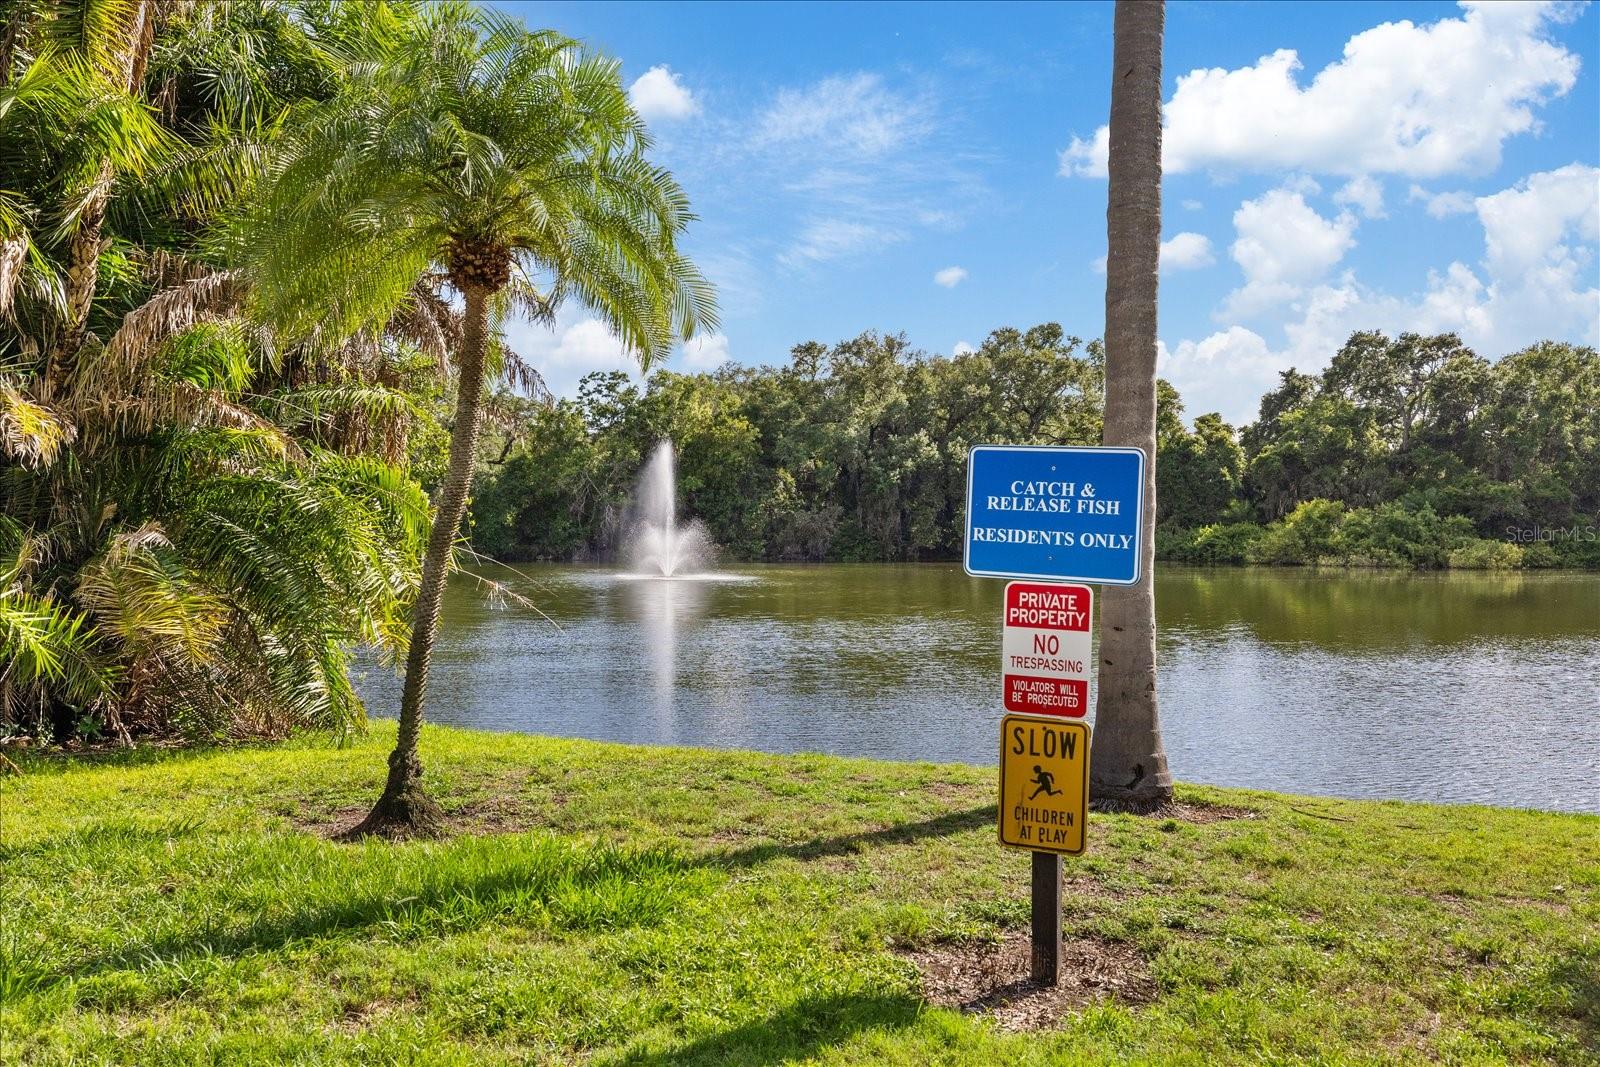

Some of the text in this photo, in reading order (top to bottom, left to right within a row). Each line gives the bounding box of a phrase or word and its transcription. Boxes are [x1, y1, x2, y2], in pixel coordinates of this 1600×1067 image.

[1011, 480, 1096, 498] CATCH &
[987, 496, 1121, 515] RELEASE FISH
[973, 527, 1133, 550] RESIDENTS ONLY
[1019, 592, 1077, 610] PRIVATE
[1009, 608, 1086, 627] PROPERTY
[1034, 634, 1059, 655] NO
[1010, 656, 1083, 673] TRESPASSING
[1012, 680, 1078, 696] VIOLATORS WILL
[1012, 692, 1078, 708] BE PROSECUTED
[1012, 726, 1077, 760] SLOW
[1014, 806, 1074, 827] CHILDREN
[1020, 825, 1068, 844] AT PLAY
